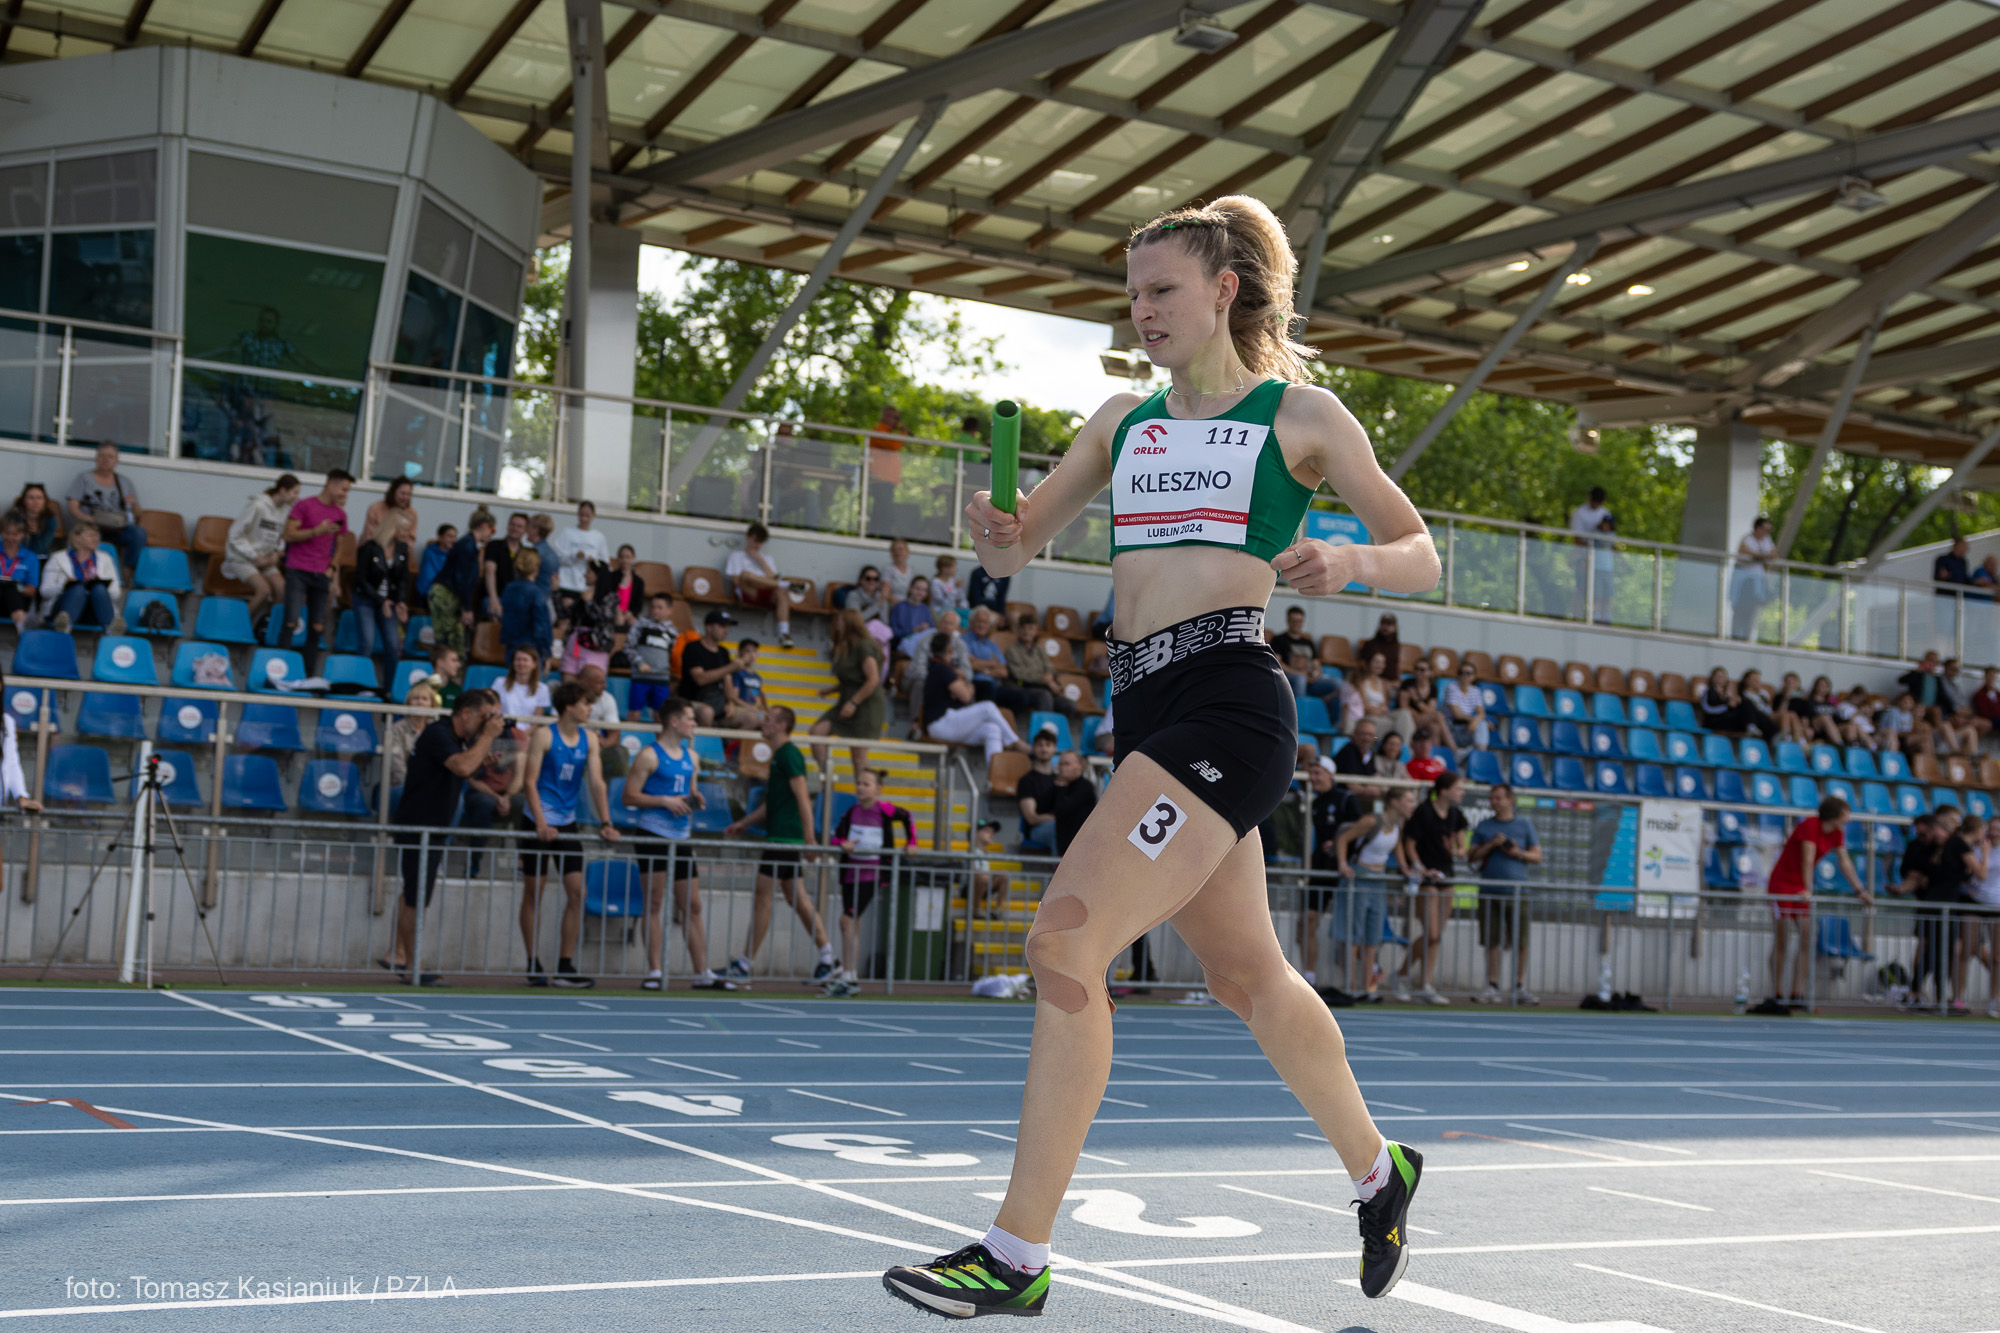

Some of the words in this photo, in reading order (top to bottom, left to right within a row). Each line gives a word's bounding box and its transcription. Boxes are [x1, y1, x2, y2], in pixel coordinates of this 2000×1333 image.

[1205, 427, 1249, 446] 111
[1133, 447, 1167, 455] ORLEN
[1131, 470, 1232, 494] KLESZNO
[1209, 511, 1244, 521] MIESZANYCH
[1147, 526, 1180, 538] LUBLIN
[1180, 523, 1203, 535] 2024
[1139, 802, 1177, 845] 3
[389, 1033, 512, 1051] 6
[482, 1058, 634, 1079] 5
[606, 1090, 744, 1117] 4
[769, 1132, 981, 1168] 3
[973, 1189, 1263, 1239] 2
